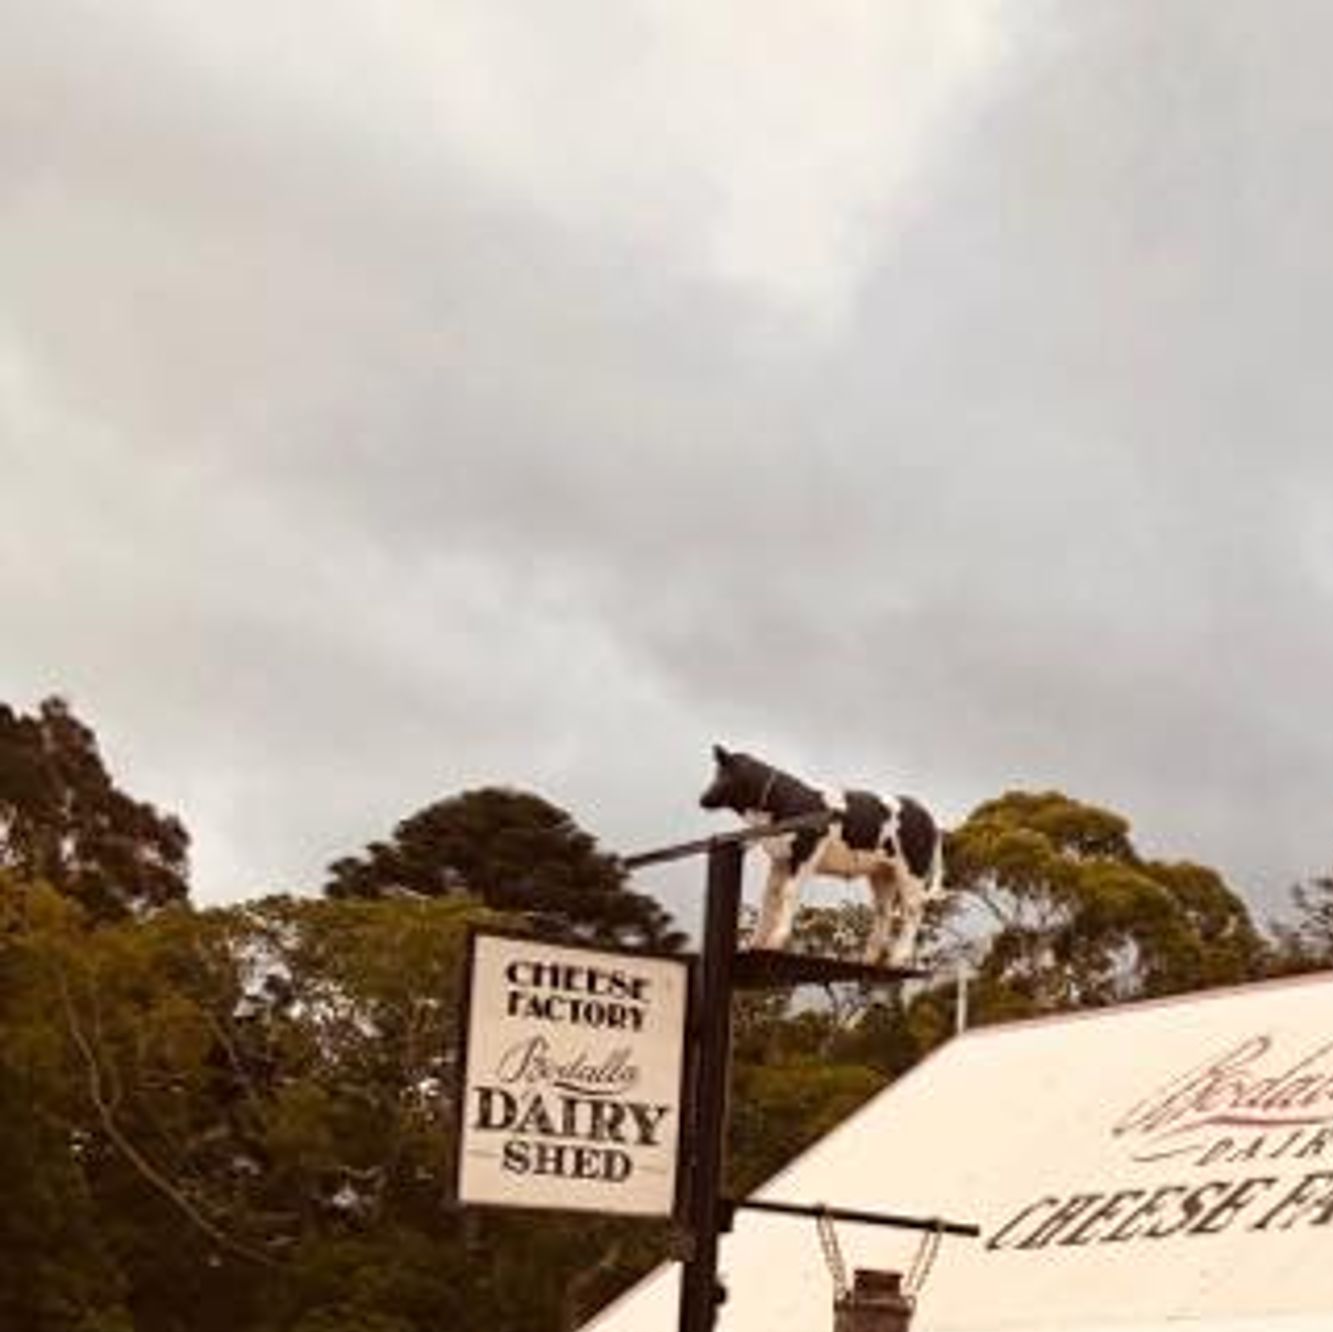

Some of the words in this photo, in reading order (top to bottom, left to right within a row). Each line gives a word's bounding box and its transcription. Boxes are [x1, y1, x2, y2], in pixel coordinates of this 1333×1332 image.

[504, 960, 651, 1001] CHEESE
[506, 990, 647, 1032] FACTORY
[472, 1086, 669, 1146] DAIRY
[502, 1139, 632, 1182] SHED
[986, 1175, 1278, 1250] CHEESE
